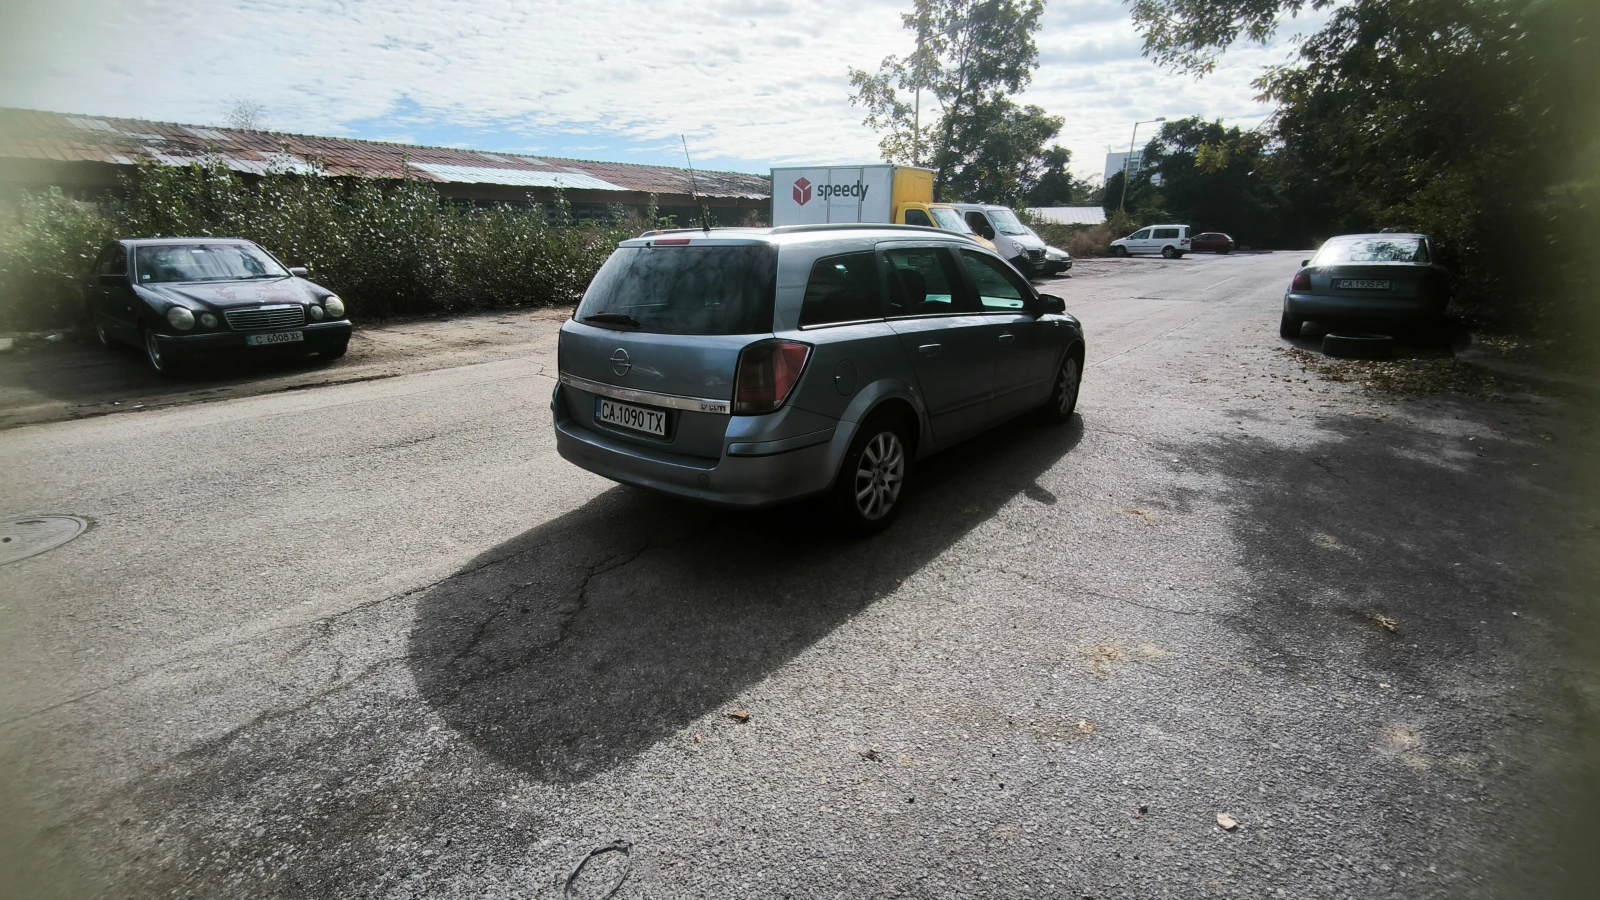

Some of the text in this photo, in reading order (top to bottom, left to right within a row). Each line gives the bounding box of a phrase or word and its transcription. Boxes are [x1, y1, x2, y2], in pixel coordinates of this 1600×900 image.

[817, 180, 869, 201] speedy
[255, 335, 263, 344] C
[267, 333, 289, 343] 6008
[618, 406, 645, 428] 1090
[647, 412, 663, 432] TX
